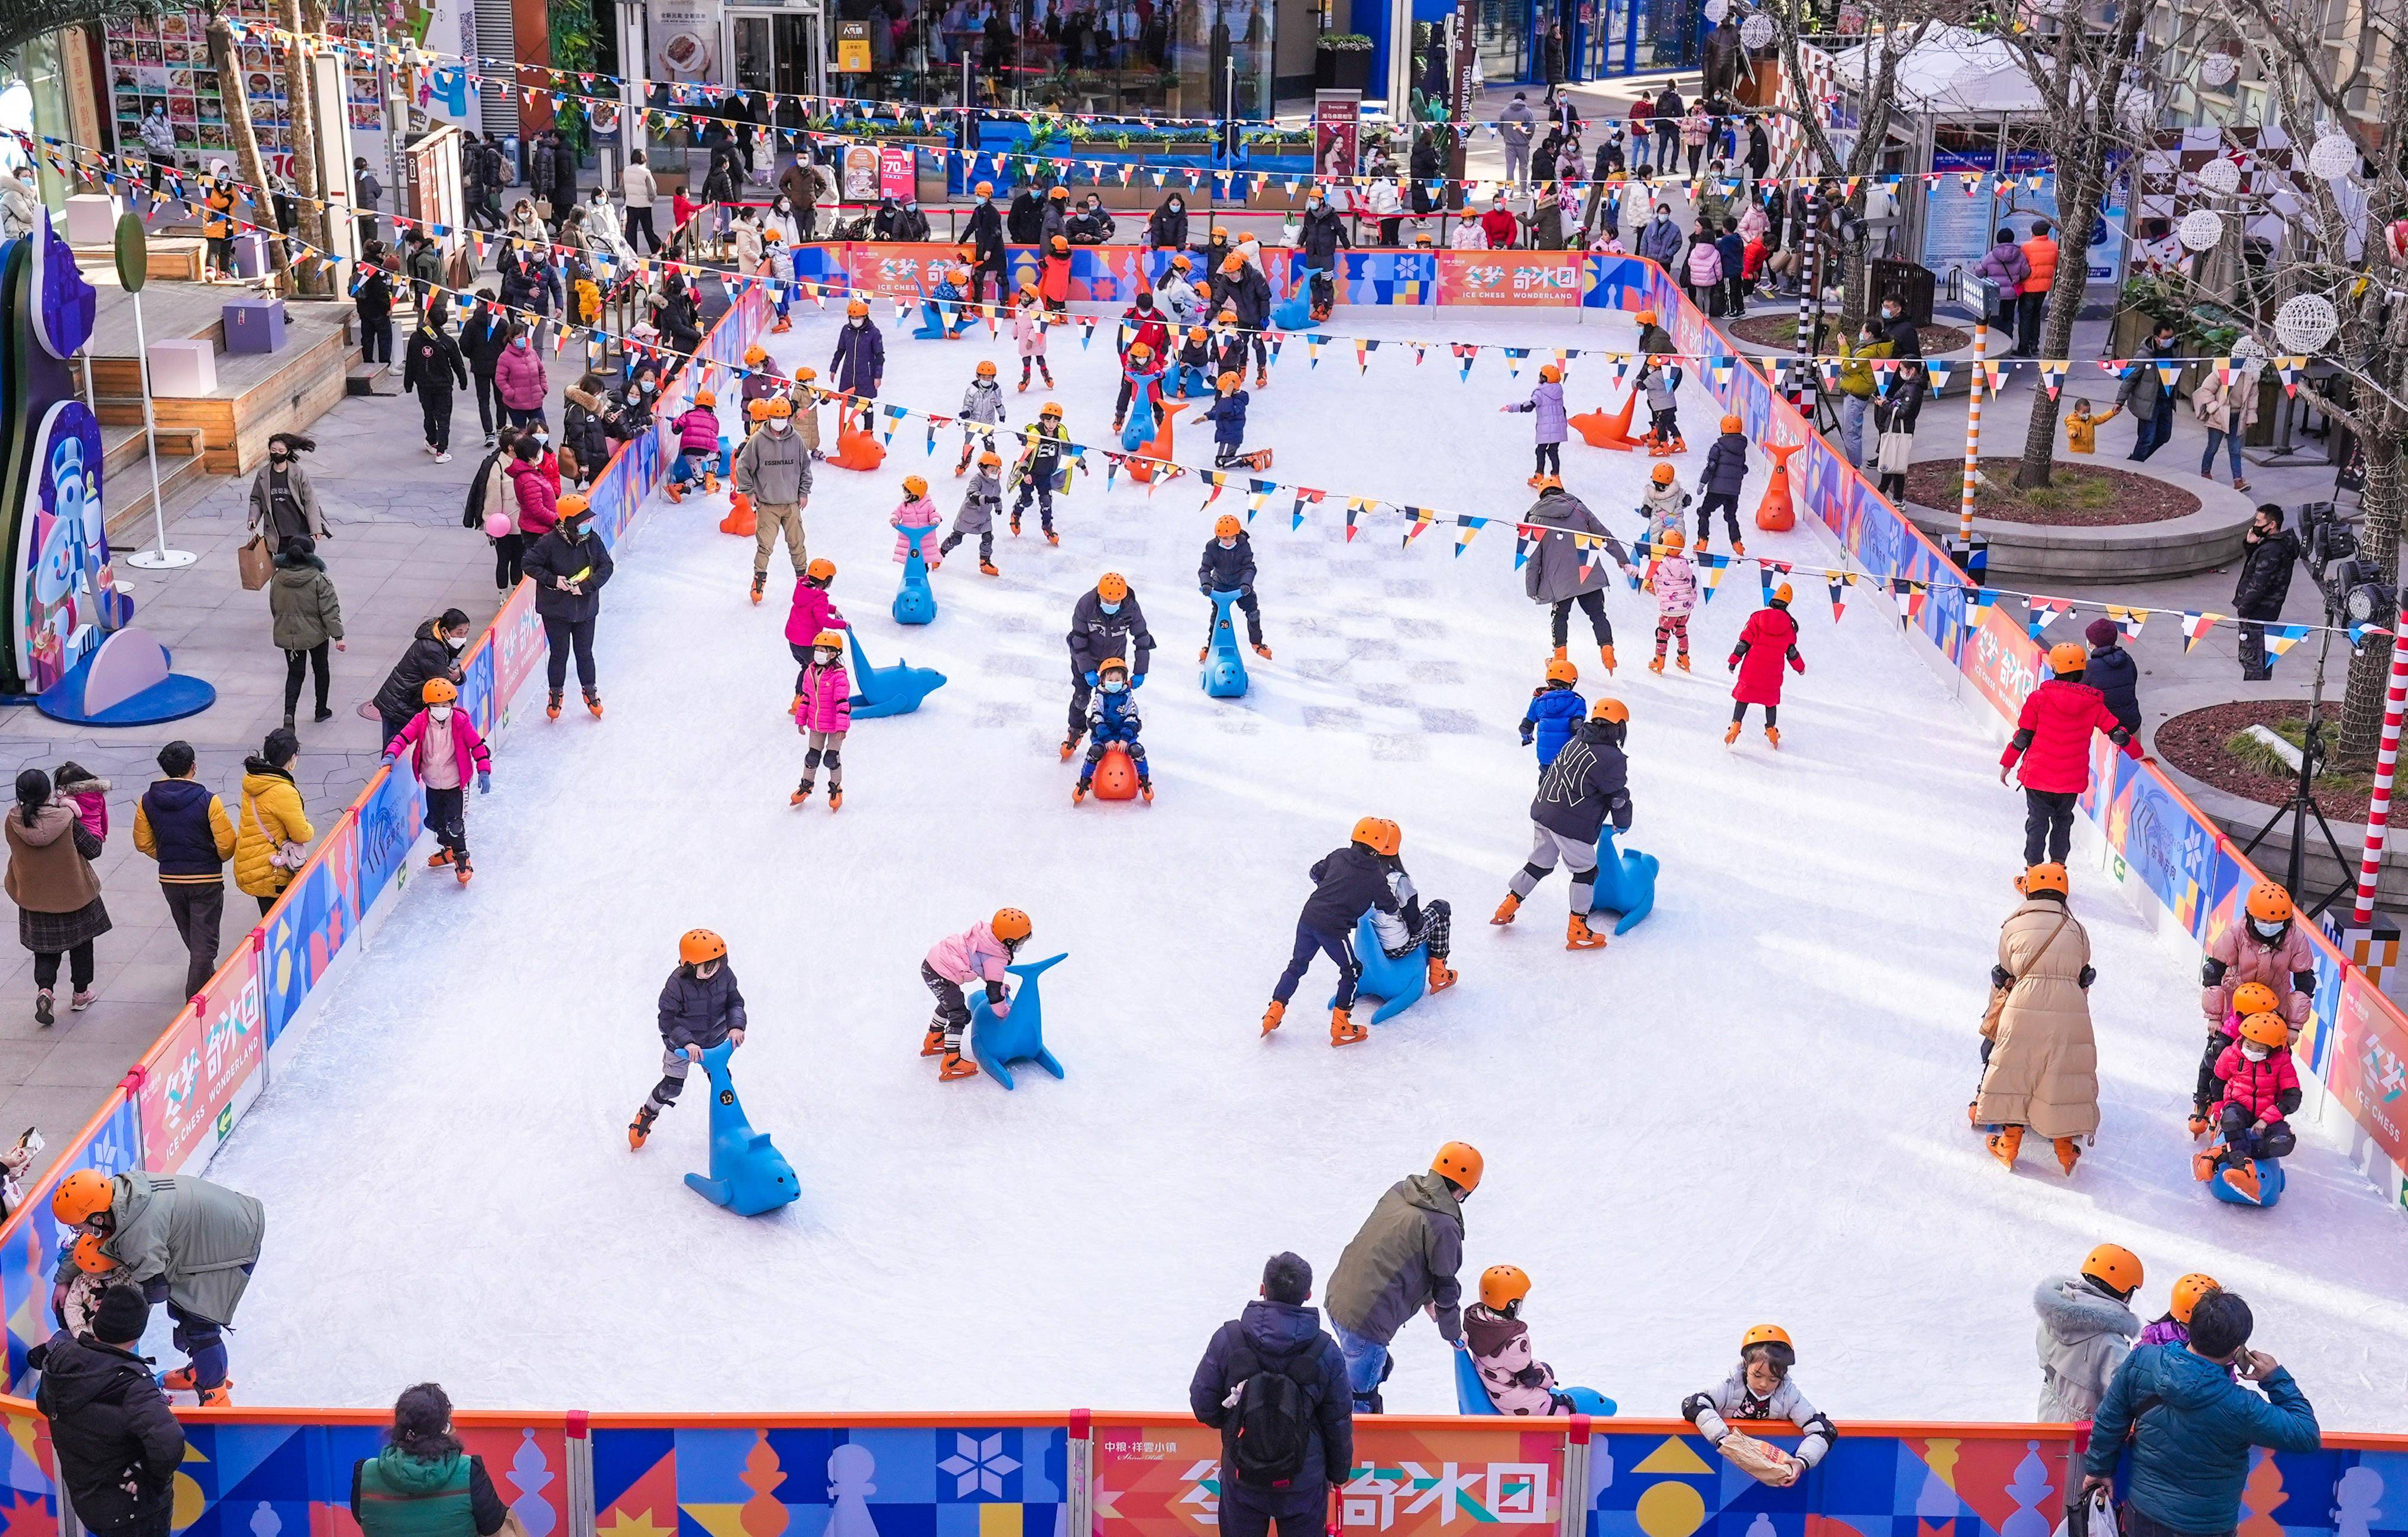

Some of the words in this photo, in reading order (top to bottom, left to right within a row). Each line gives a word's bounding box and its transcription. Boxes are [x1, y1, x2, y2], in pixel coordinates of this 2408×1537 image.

[1455, 5, 1465, 51] 喷泉广场
[1461, 65, 1471, 112] FOUNTAIN
[1982, 671, 1996, 691] CHESS
[166, 1135, 179, 1161] ICE
[181, 1104, 205, 1142] CHESS
[208, 1036, 258, 1104] WONDERLAND
[721, 1095, 733, 1104] 12
[2355, 1086, 2370, 1111] ICE
[2372, 1104, 2400, 1143] CHESS
[1105, 1441, 1177, 1453] 中粮·祥雲小镇
